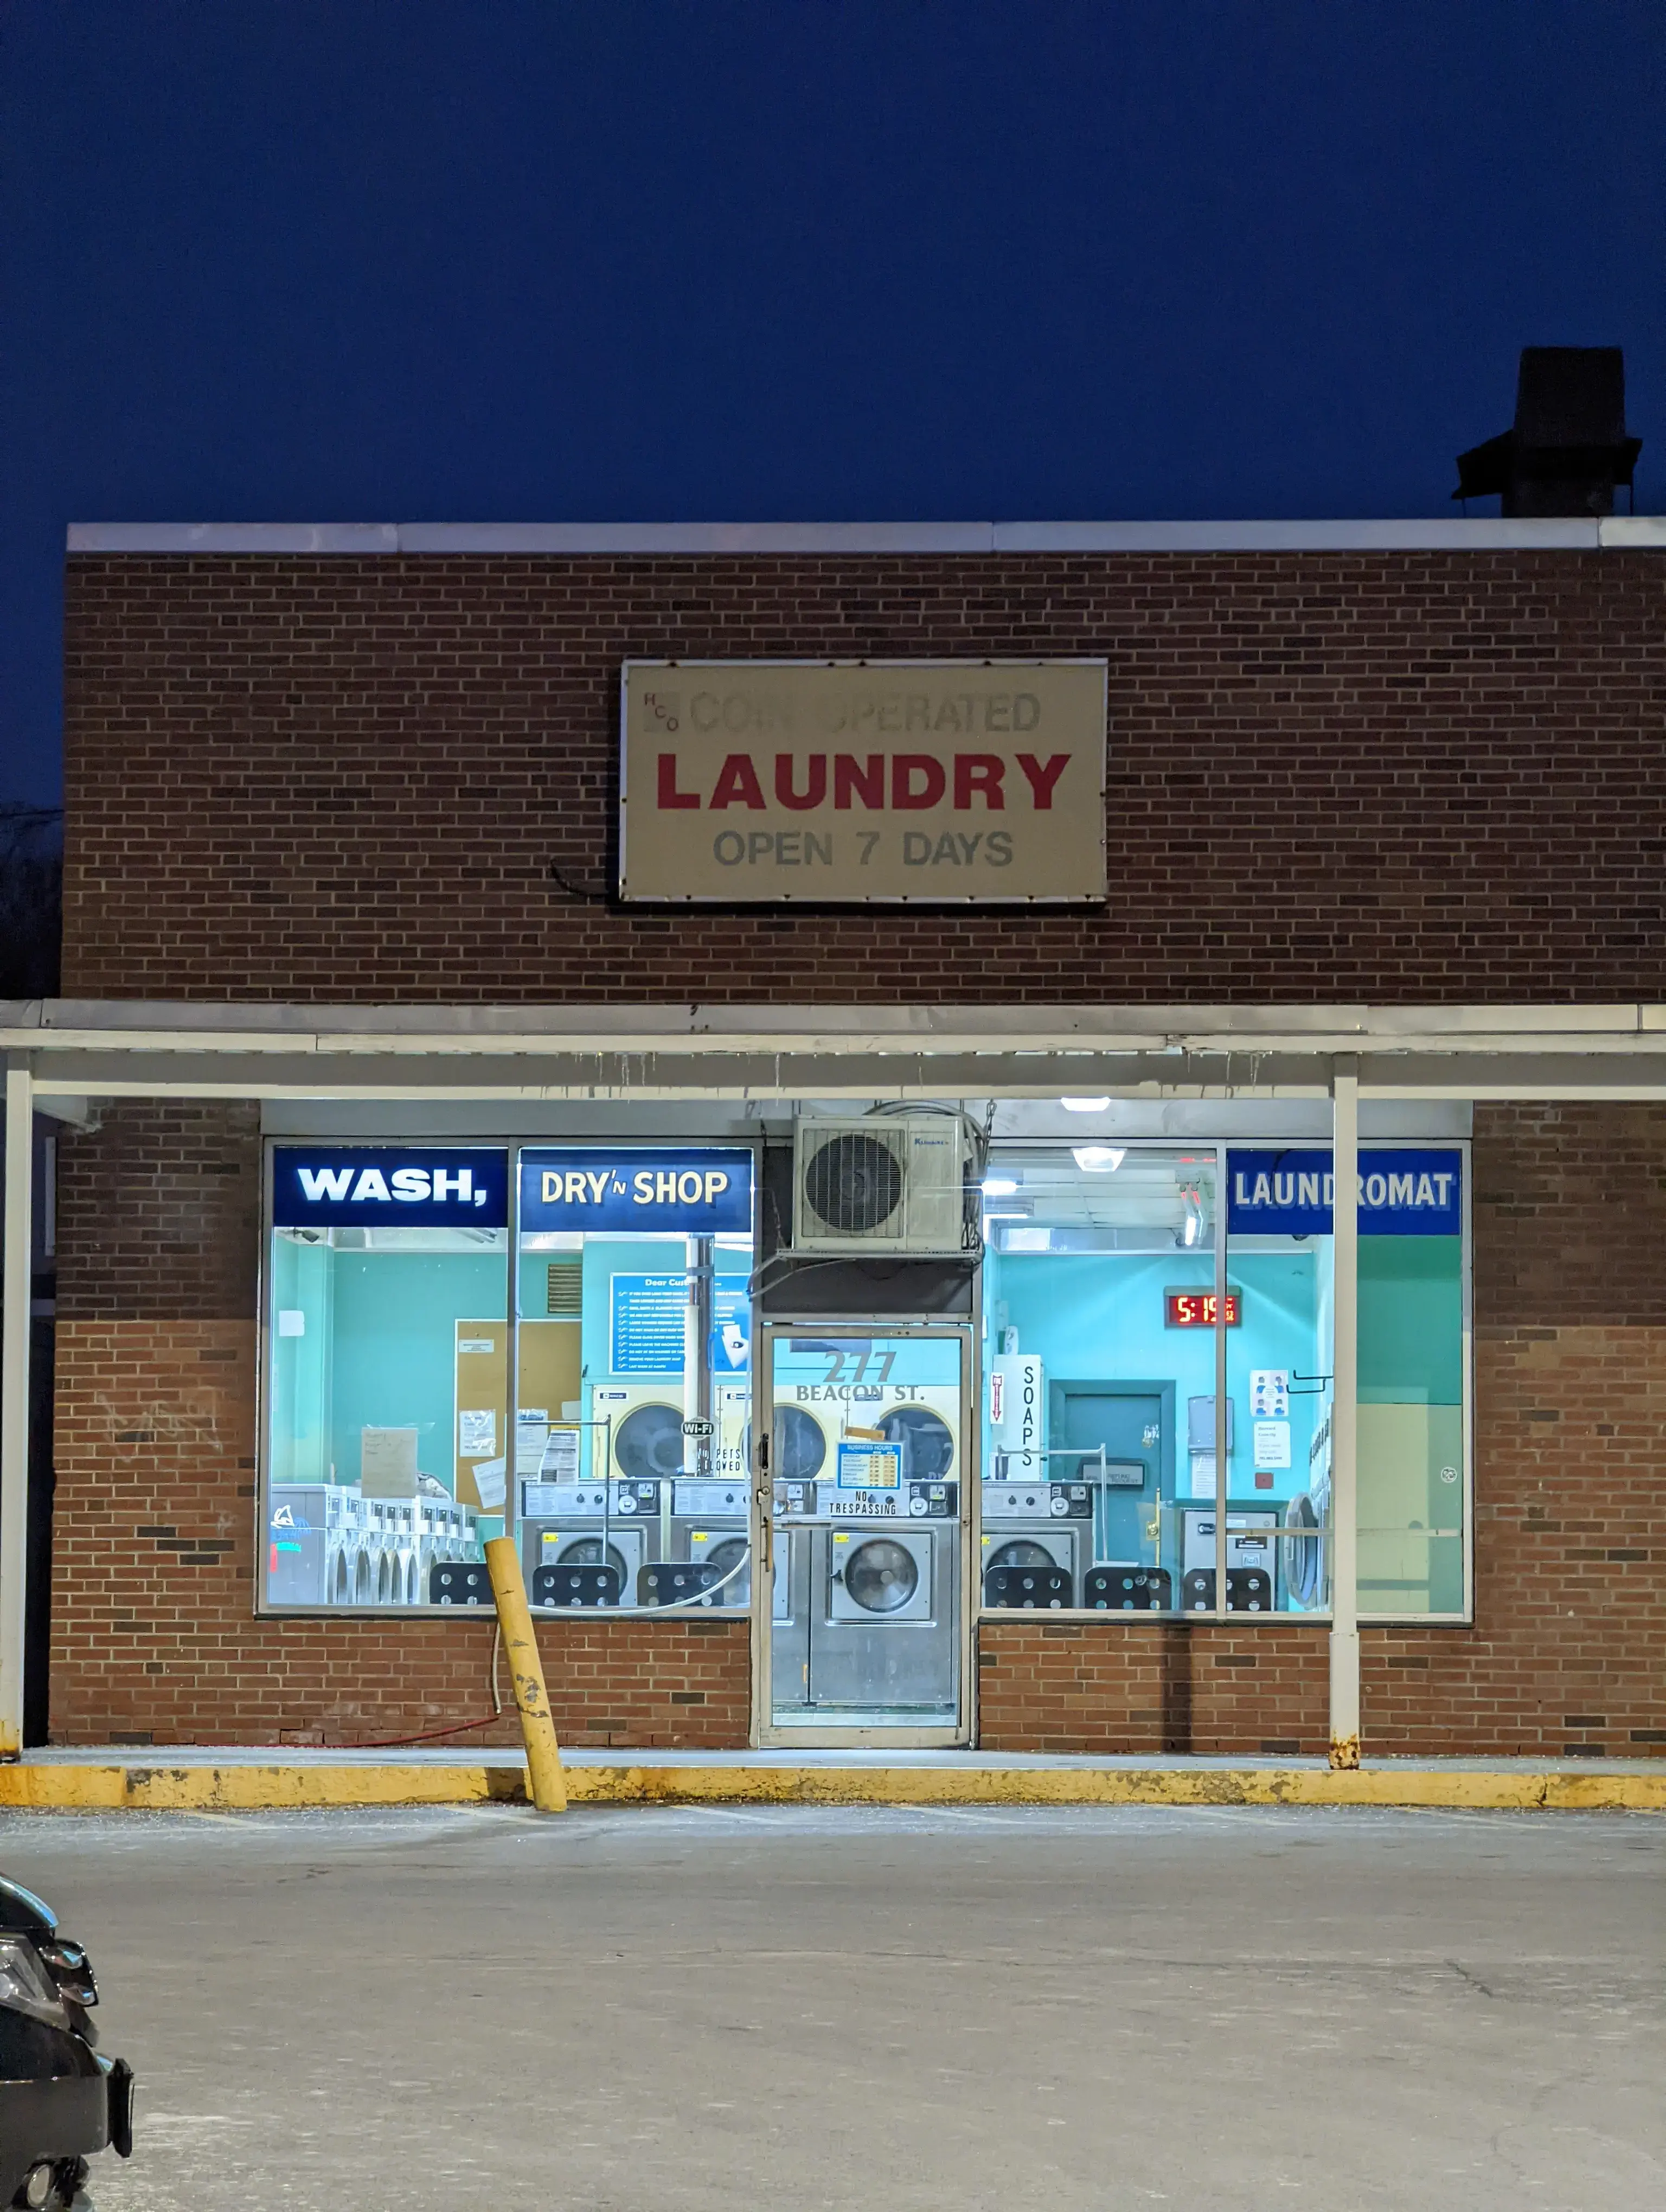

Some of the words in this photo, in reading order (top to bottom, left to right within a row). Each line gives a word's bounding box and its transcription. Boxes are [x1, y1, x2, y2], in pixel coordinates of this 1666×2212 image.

[657, 754, 1073, 810] LAUNDRY
[713, 830, 832, 866] OPEN
[857, 832, 880, 865] 7
[903, 831, 1013, 866] DAYS
[298, 1168, 487, 1207] WASH,
[632, 1171, 728, 1205] SHOP
[645, 1278, 667, 1287] Dear
[823, 1351, 896, 1382] 277
[796, 1385, 883, 1401] BEACON
[895, 1385, 925, 1400] ST.
[1022, 1366, 1034, 1466] SOAPS
[716, 1449, 740, 1459] PETS
[830, 1503, 896, 1515] TRESPASSING
[855, 1491, 867, 1501] NO
